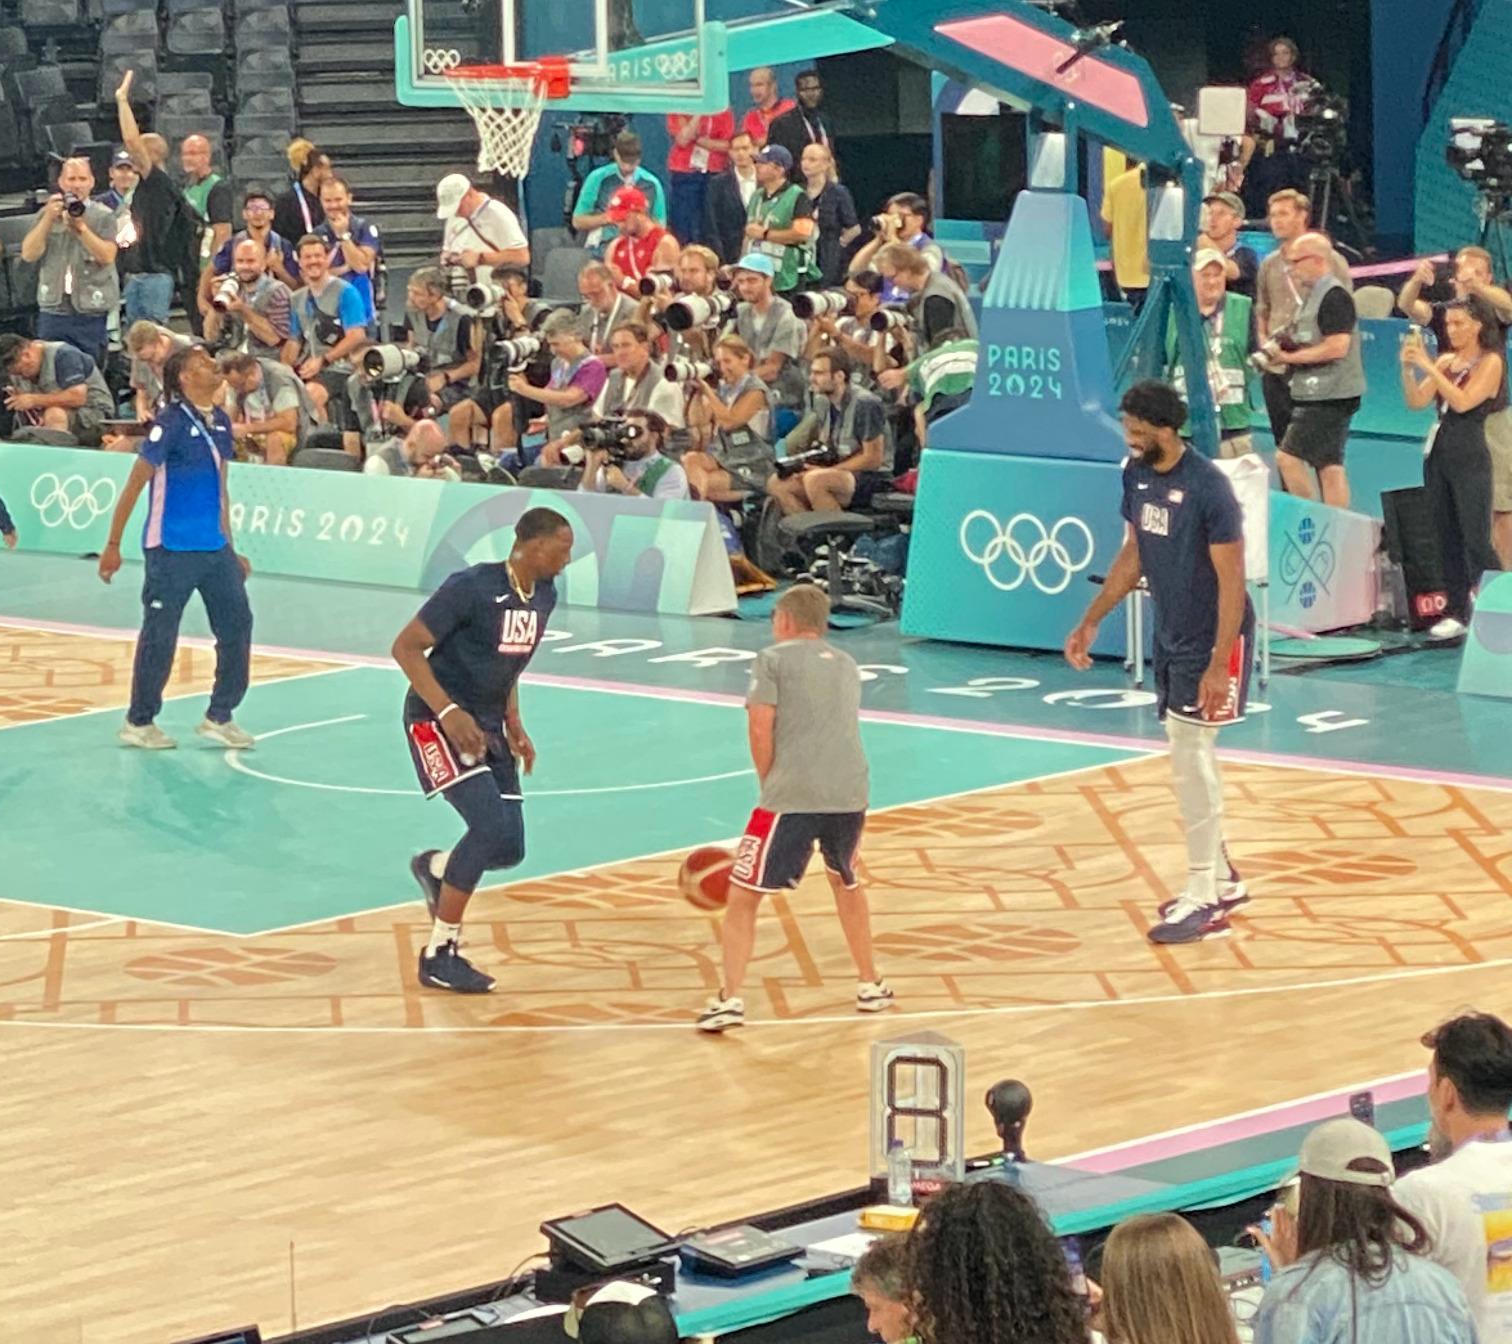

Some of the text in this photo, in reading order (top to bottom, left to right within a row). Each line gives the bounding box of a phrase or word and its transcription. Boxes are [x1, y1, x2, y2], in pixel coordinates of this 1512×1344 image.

[988, 344, 1060, 371] PARIS
[989, 372, 1062, 400] 2024
[229, 503, 409, 548] ARIS 2024
[502, 609, 538, 644] USA
